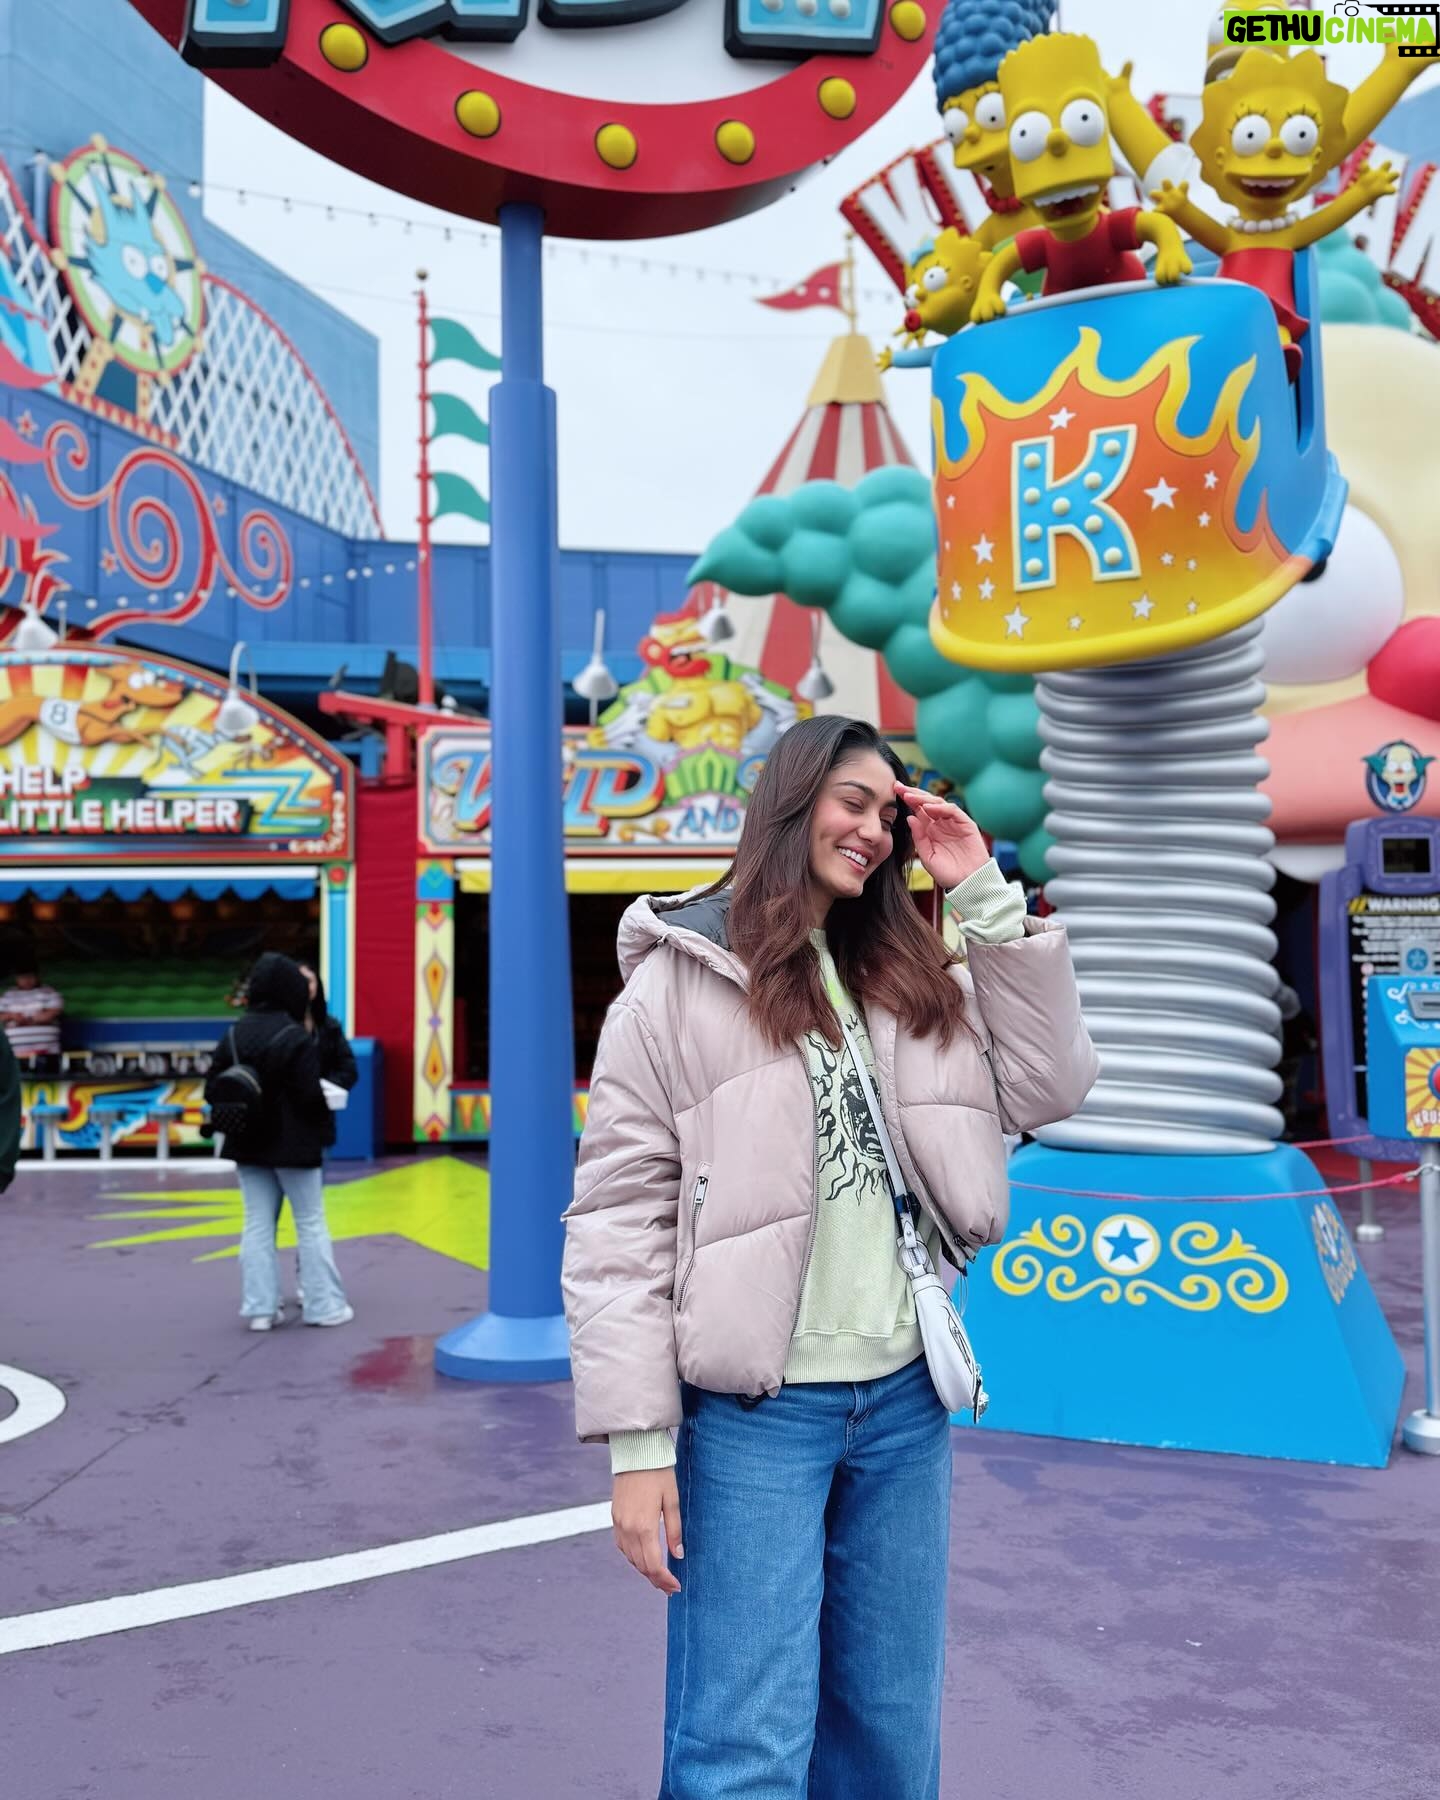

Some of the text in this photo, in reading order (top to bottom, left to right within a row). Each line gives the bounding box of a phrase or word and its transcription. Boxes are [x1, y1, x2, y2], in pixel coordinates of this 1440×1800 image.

[1011, 423, 1141, 593] K
[0, 765, 88, 797] HELP
[432, 750, 666, 838] WLD
[110, 799, 240, 830] HELPER
[673, 799, 740, 838] AND
[1413, 1109, 1440, 1128] KRU
